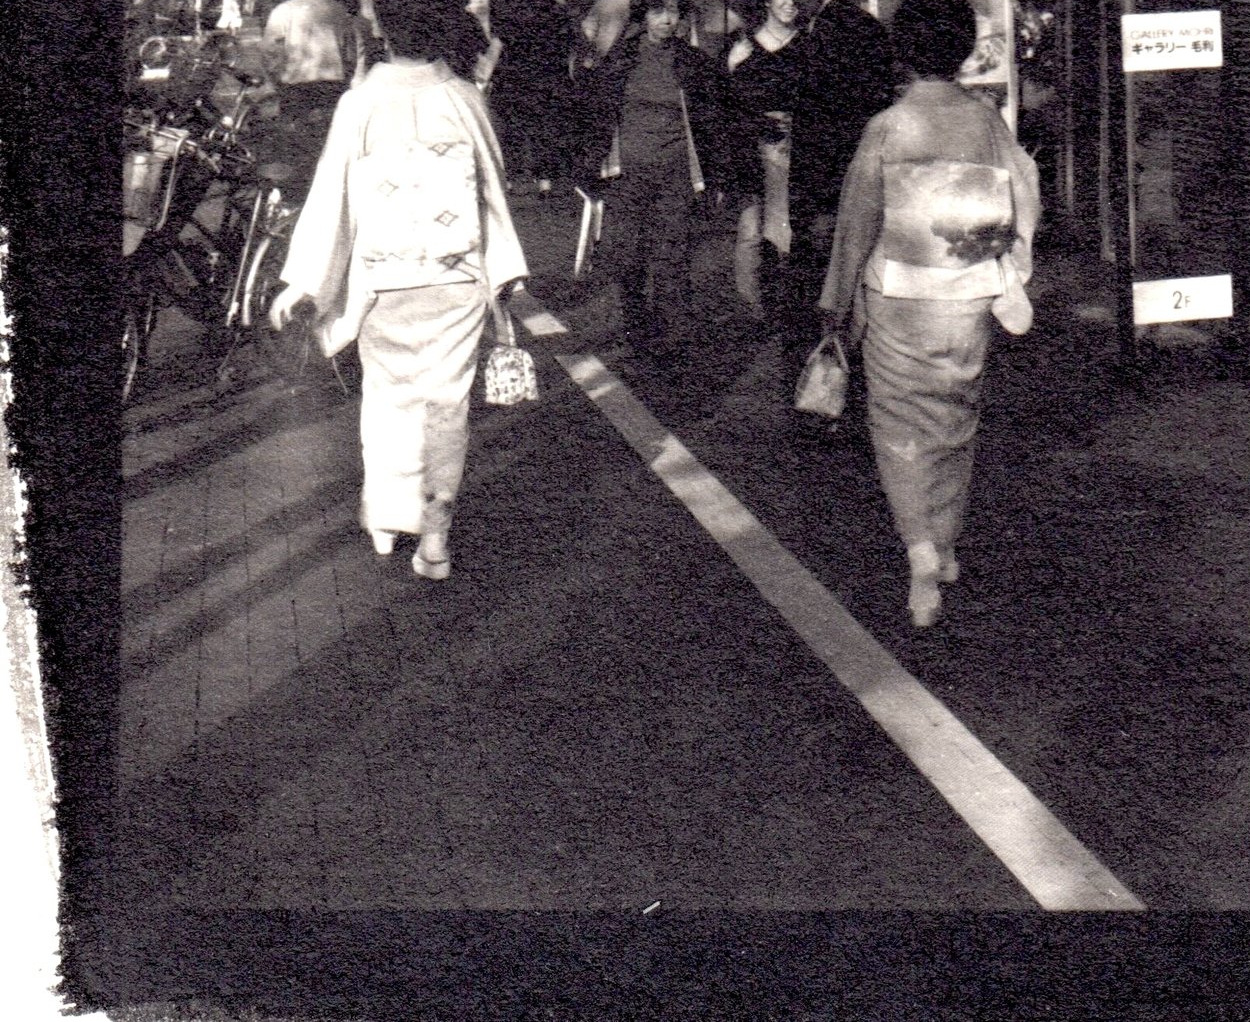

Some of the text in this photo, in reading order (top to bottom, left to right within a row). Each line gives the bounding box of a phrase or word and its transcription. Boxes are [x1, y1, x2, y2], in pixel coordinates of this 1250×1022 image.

[1131, 39, 1215, 55] ギャラリー 毛利
[1173, 290, 1191, 310] 2F
